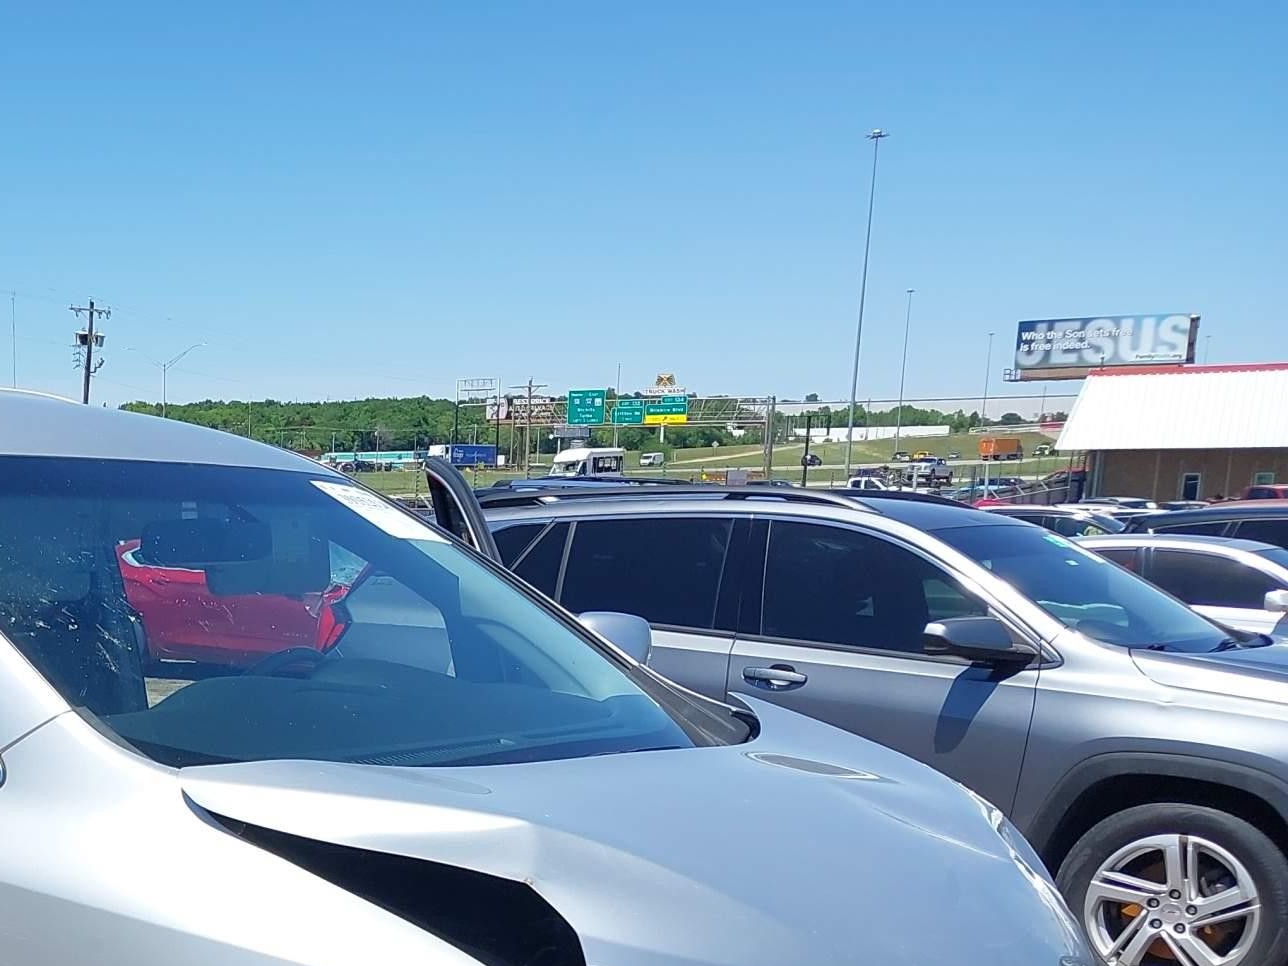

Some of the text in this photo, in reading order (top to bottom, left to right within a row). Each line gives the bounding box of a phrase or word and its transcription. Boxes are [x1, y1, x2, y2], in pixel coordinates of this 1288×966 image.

[1016, 315, 1190, 366] JESUS
[1021, 332, 1044, 341] Who
[1046, 331, 1063, 340] the
[1065, 329, 1086, 339] Son
[1112, 327, 1133, 337] free
[1019, 340, 1090, 352] is free indeed.
